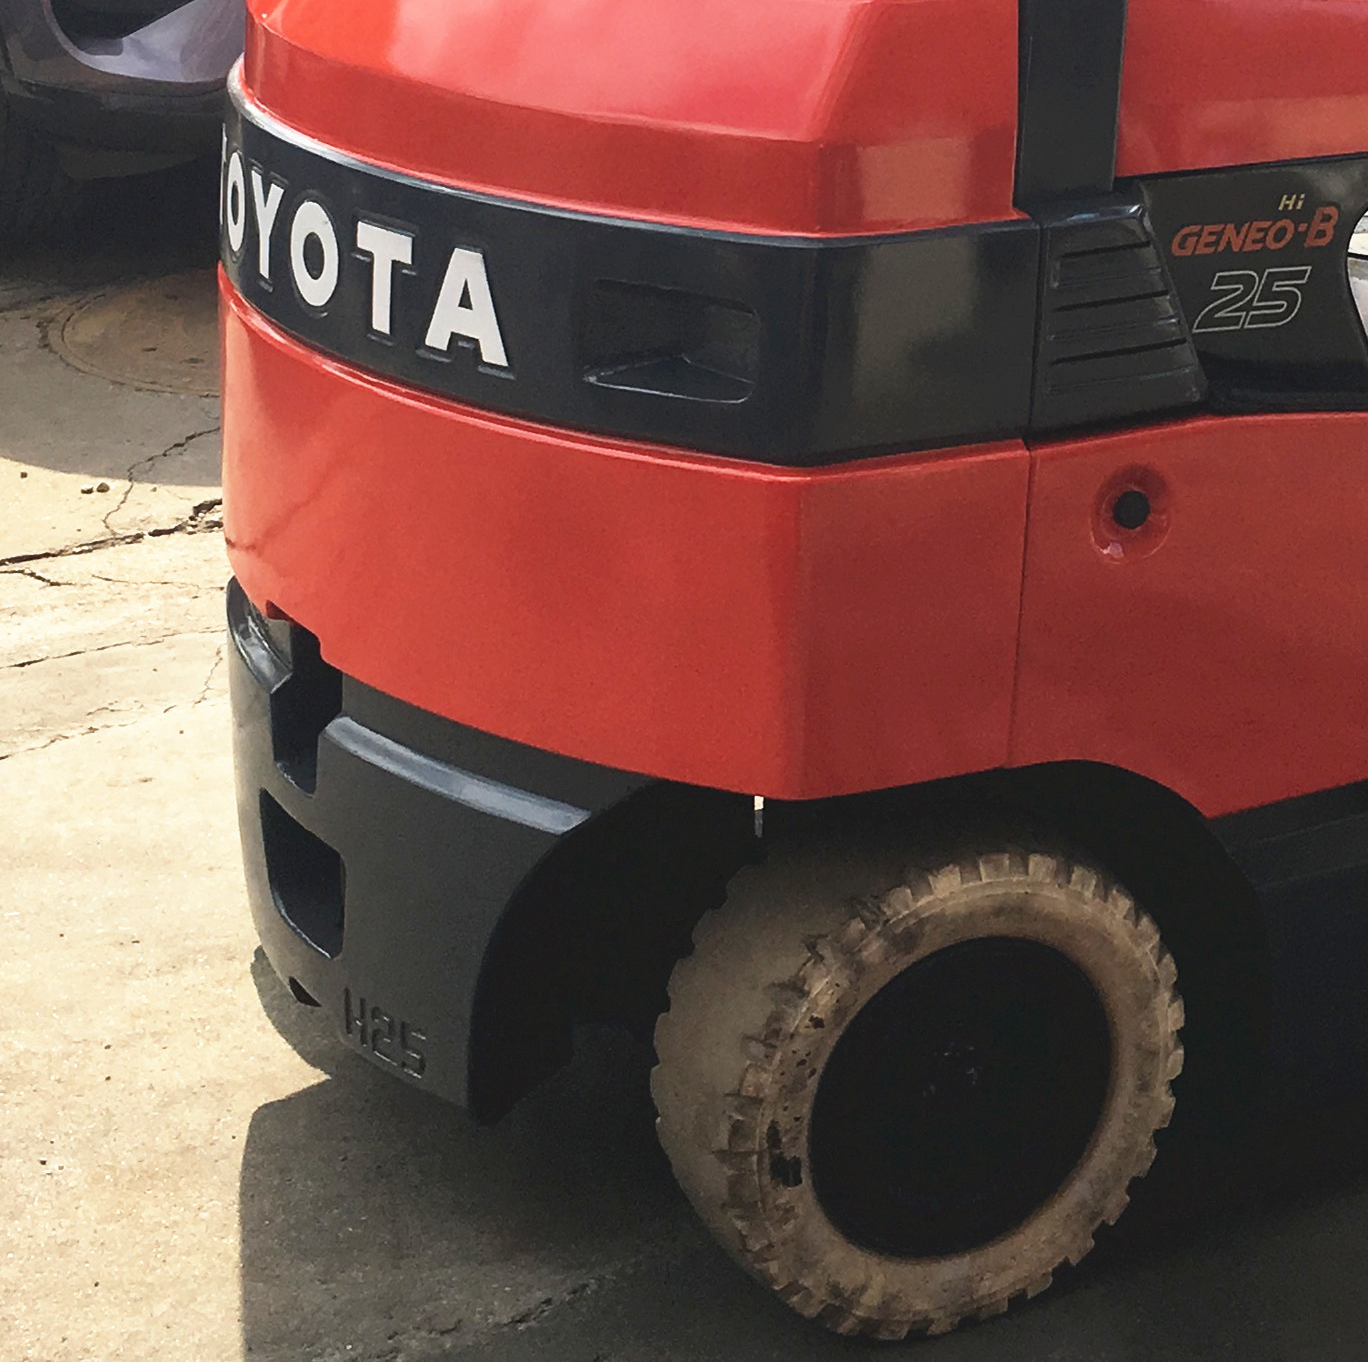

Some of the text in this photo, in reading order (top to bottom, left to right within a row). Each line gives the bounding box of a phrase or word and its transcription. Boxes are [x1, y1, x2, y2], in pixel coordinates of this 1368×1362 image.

[1278, 194, 1305, 211] Hi
[221, 140, 509, 367] OYOTA
[1192, 266, 1312, 334] 25
[345, 988, 427, 1079] H25
